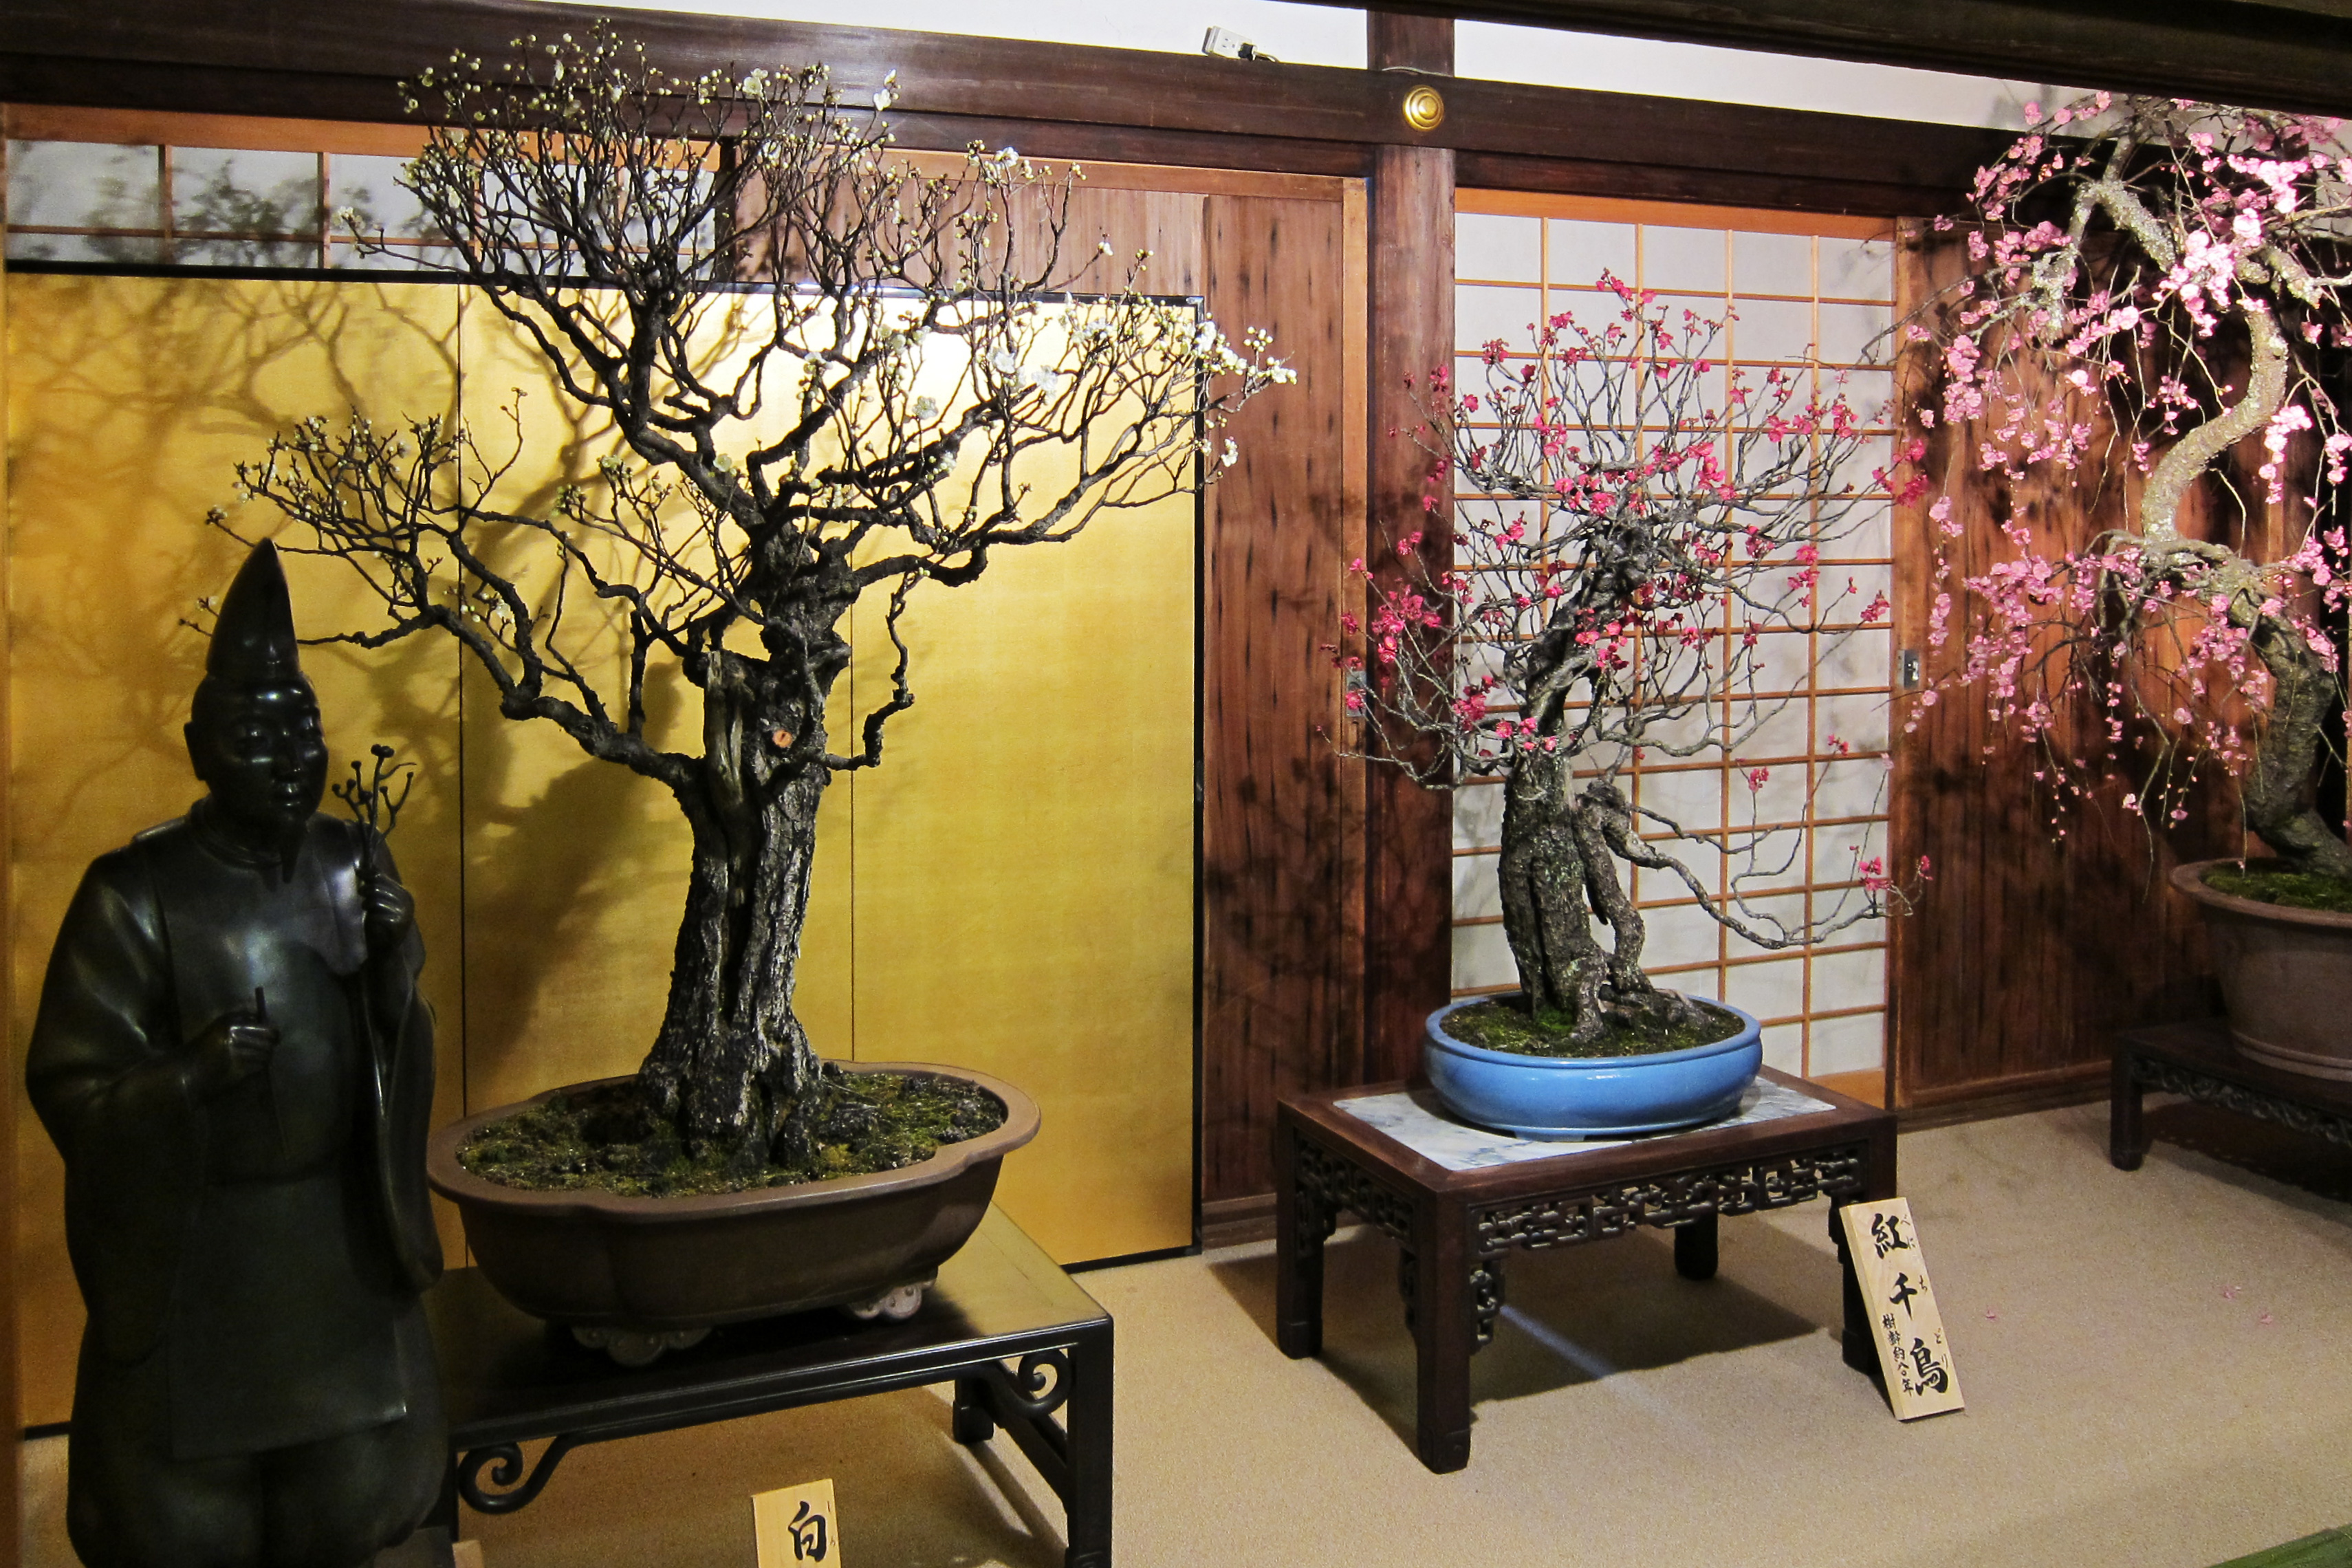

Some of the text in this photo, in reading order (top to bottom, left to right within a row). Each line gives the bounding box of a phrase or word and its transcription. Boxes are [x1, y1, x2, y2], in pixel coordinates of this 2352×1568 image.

[1871, 1213, 1948, 1396] 紅千鳥
[788, 1501, 827, 1562] 白
